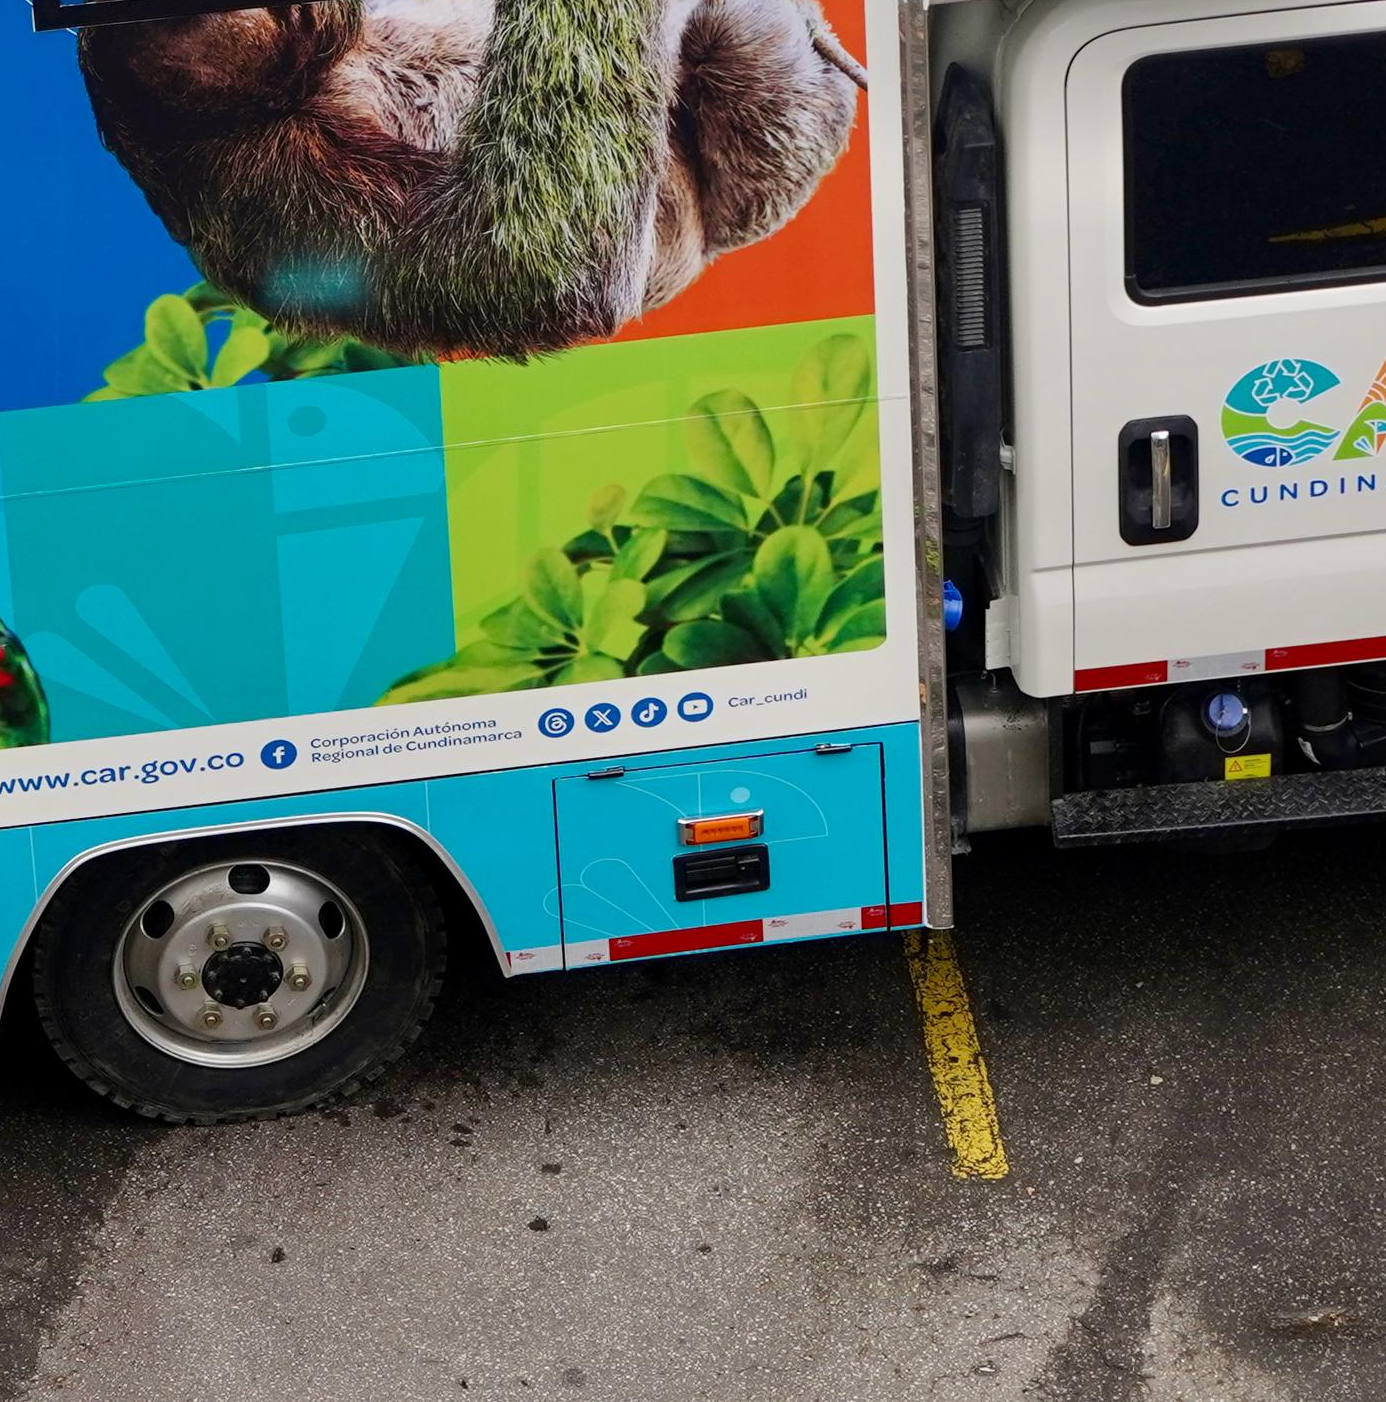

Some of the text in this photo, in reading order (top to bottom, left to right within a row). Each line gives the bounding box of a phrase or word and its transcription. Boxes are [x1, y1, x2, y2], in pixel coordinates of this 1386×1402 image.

[728, 688, 807, 708] Car_cundi
[310, 719, 497, 748] Corporación Autónoma
[311, 730, 522, 763] Regional de Cundinamarca
